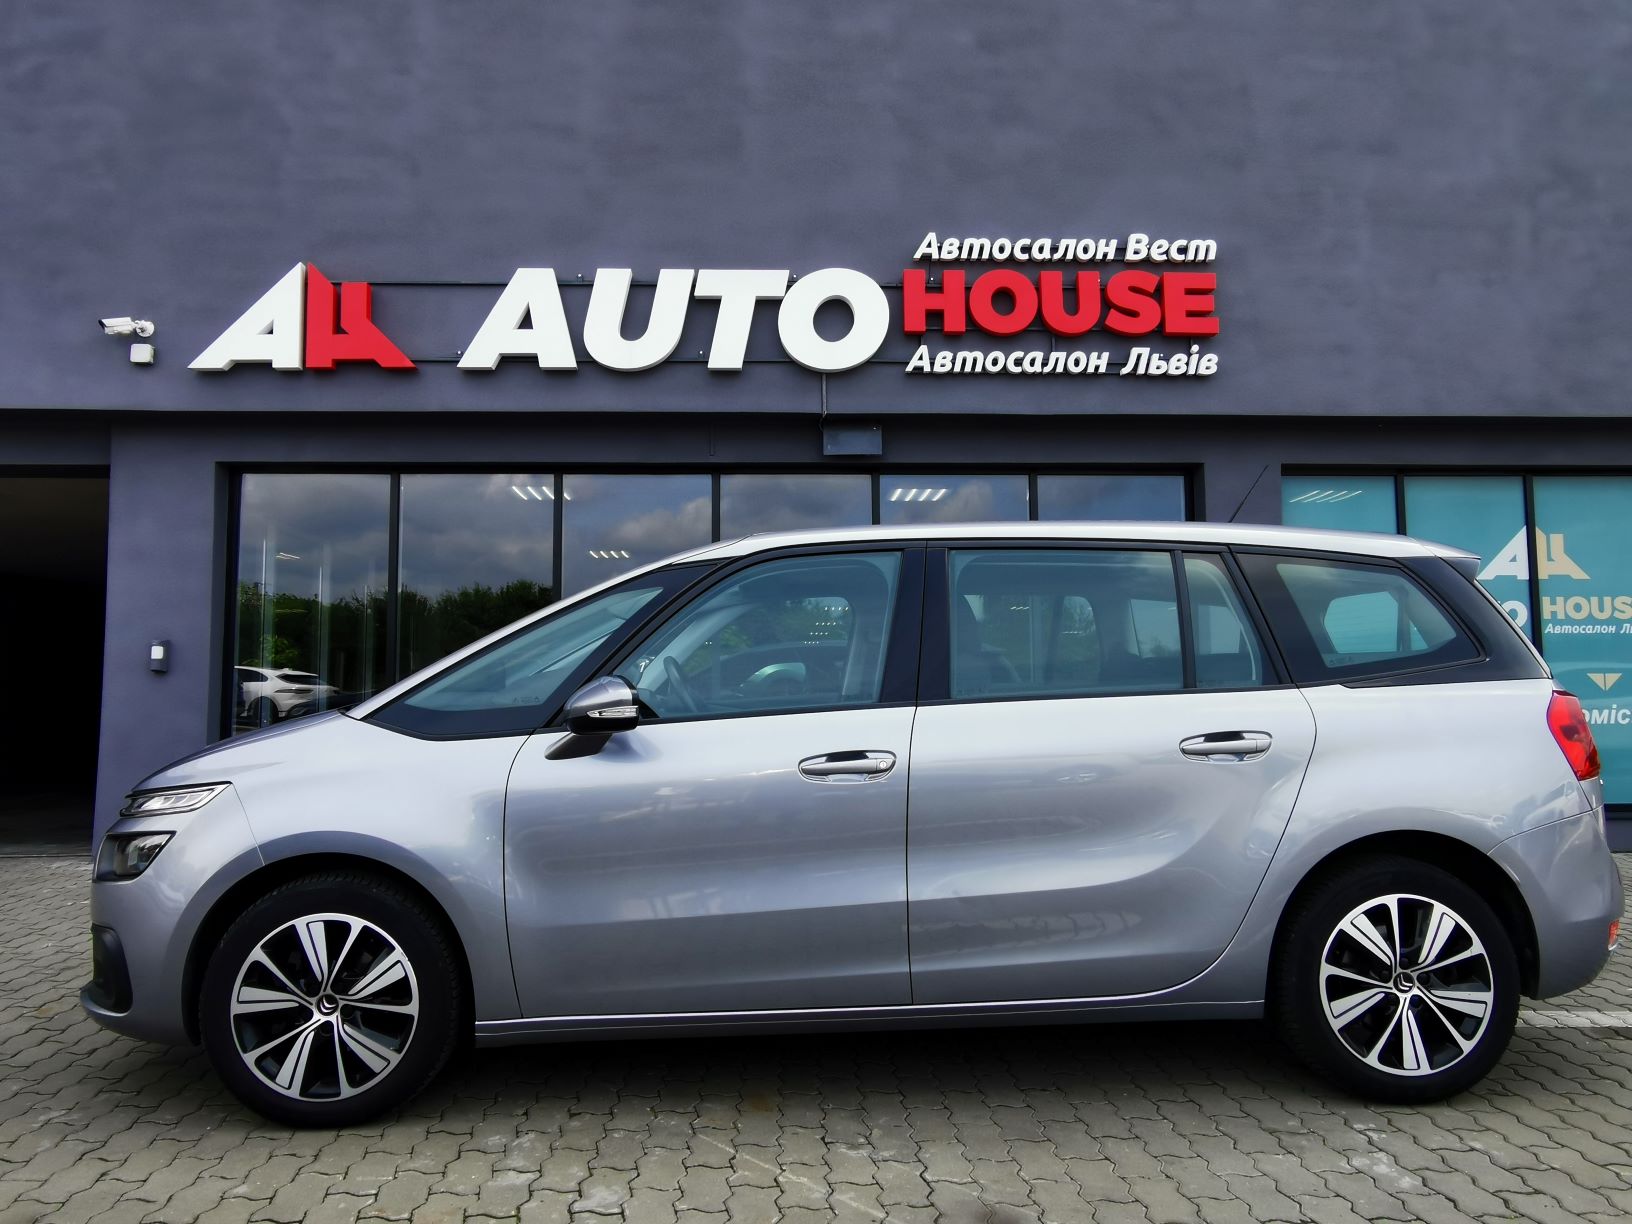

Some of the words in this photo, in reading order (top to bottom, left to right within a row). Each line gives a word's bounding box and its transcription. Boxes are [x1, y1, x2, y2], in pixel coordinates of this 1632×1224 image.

[913, 232, 1118, 261] Автосалон
[1123, 233, 1217, 262] Вест
[902, 268, 1220, 337] HOUSE
[458, 267, 890, 372] AUTO
[905, 345, 1109, 374] Автосалон
[1120, 344, 1219, 377] Львів
[1545, 623, 1616, 634] Автосалон
